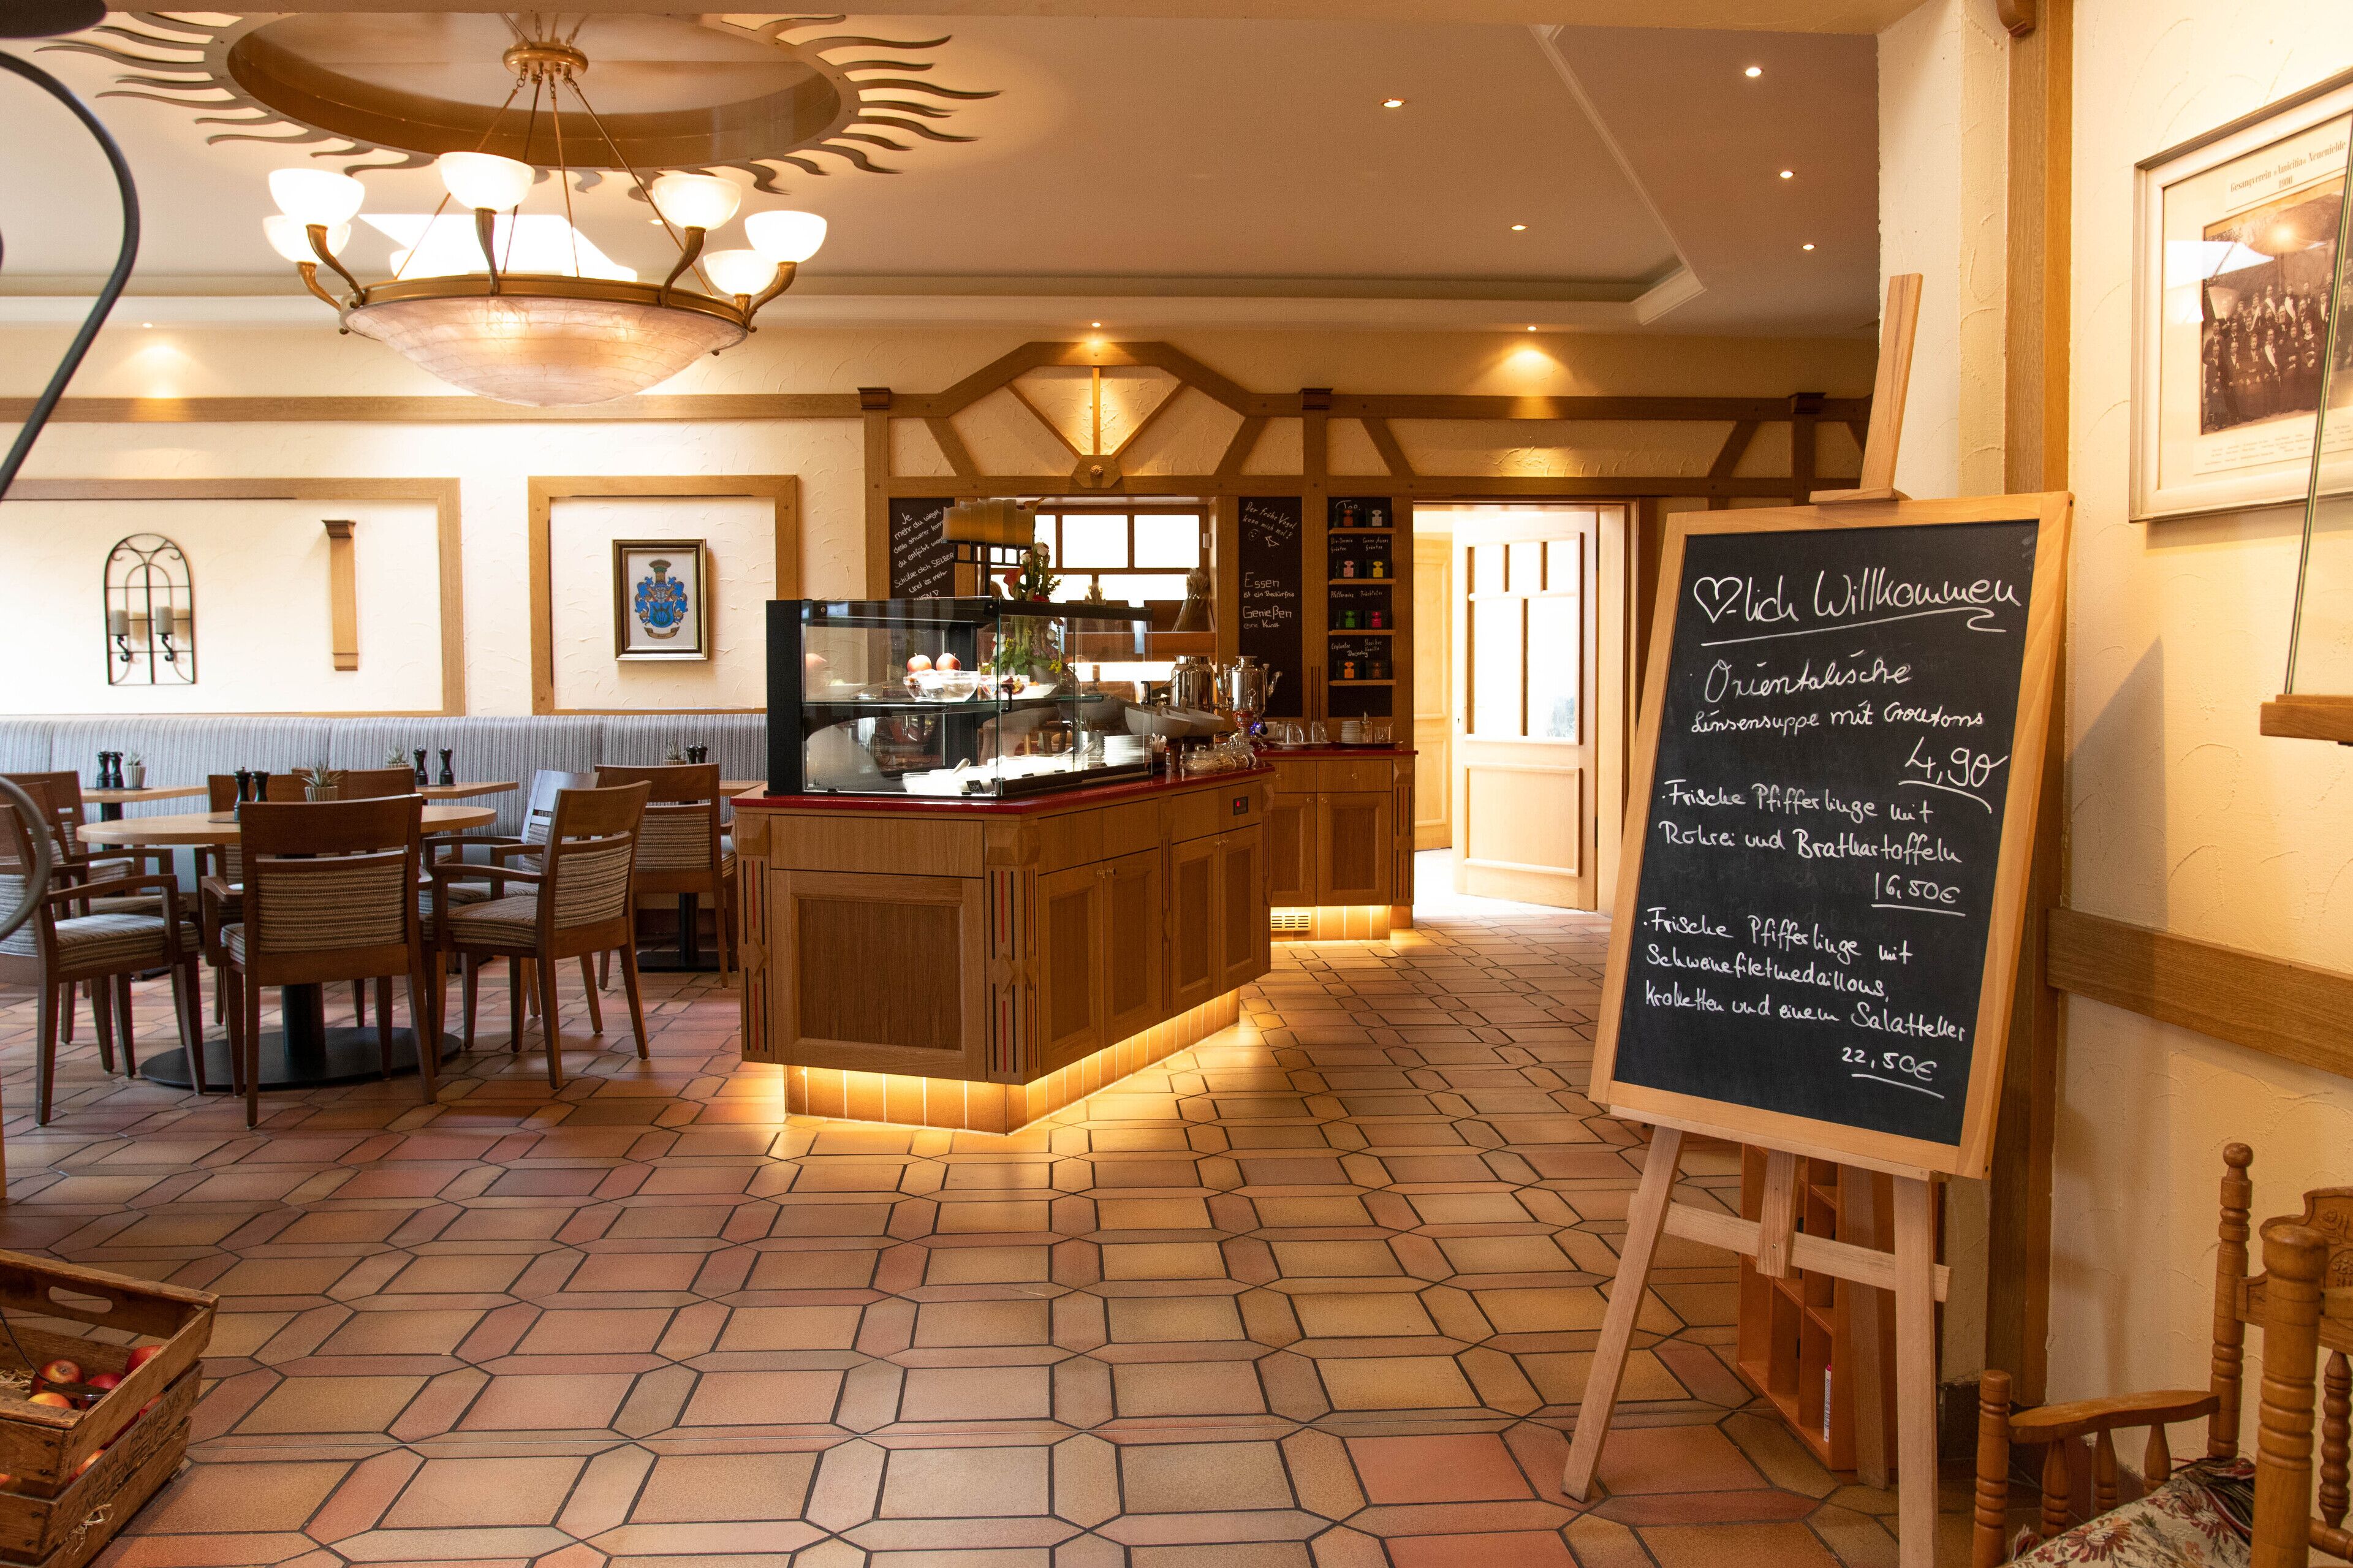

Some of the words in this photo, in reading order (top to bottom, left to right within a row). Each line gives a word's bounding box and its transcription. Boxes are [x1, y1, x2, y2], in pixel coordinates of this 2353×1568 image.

[2230, 170, 2272, 192] Gesangverein
[2279, 175, 2293, 189] 1900
[901, 513, 912, 525] Je
[1242, 514, 1259, 525] kann
[1245, 501, 1258, 512] Der
[1259, 507, 1278, 521] frühe
[1278, 513, 1298, 529] Vogel
[894, 526, 912, 540] mehr
[898, 559, 907, 568] du
[907, 544, 930, 561] entführt
[933, 571, 948, 581] mehr
[1245, 572, 1279, 589] Essen
[1264, 589, 1295, 599] Bedürfnis
[1814, 567, 2021, 618] Willkommen
[1243, 605, 1292, 620] Genießen
[1262, 619, 1280, 628] Kunst
[1705, 650, 1911, 703] Orientalische
[1691, 710, 1819, 735] Linsensuppe
[1831, 700, 1873, 725] mit
[1664, 779, 1746, 806] Frische
[1752, 783, 1877, 823] Pfifferlinge
[1891, 800, 1933, 823] mit
[1745, 830, 1786, 849] und
[1792, 828, 1961, 865] Bratkartoffeln
[1876, 873, 1960, 903] 16,50€
[1647, 907, 1733, 937] Frische
[1748, 915, 1861, 964] Pfifferlinge
[1879, 941, 1912, 964] mit
[1646, 980, 1724, 1011] Kroketten
[1732, 994, 1770, 1015] und
[1779, 1005, 1840, 1021] einem
[1851, 1002, 1965, 1041] Salatteller
[1842, 1047, 1937, 1081] 22,50€
